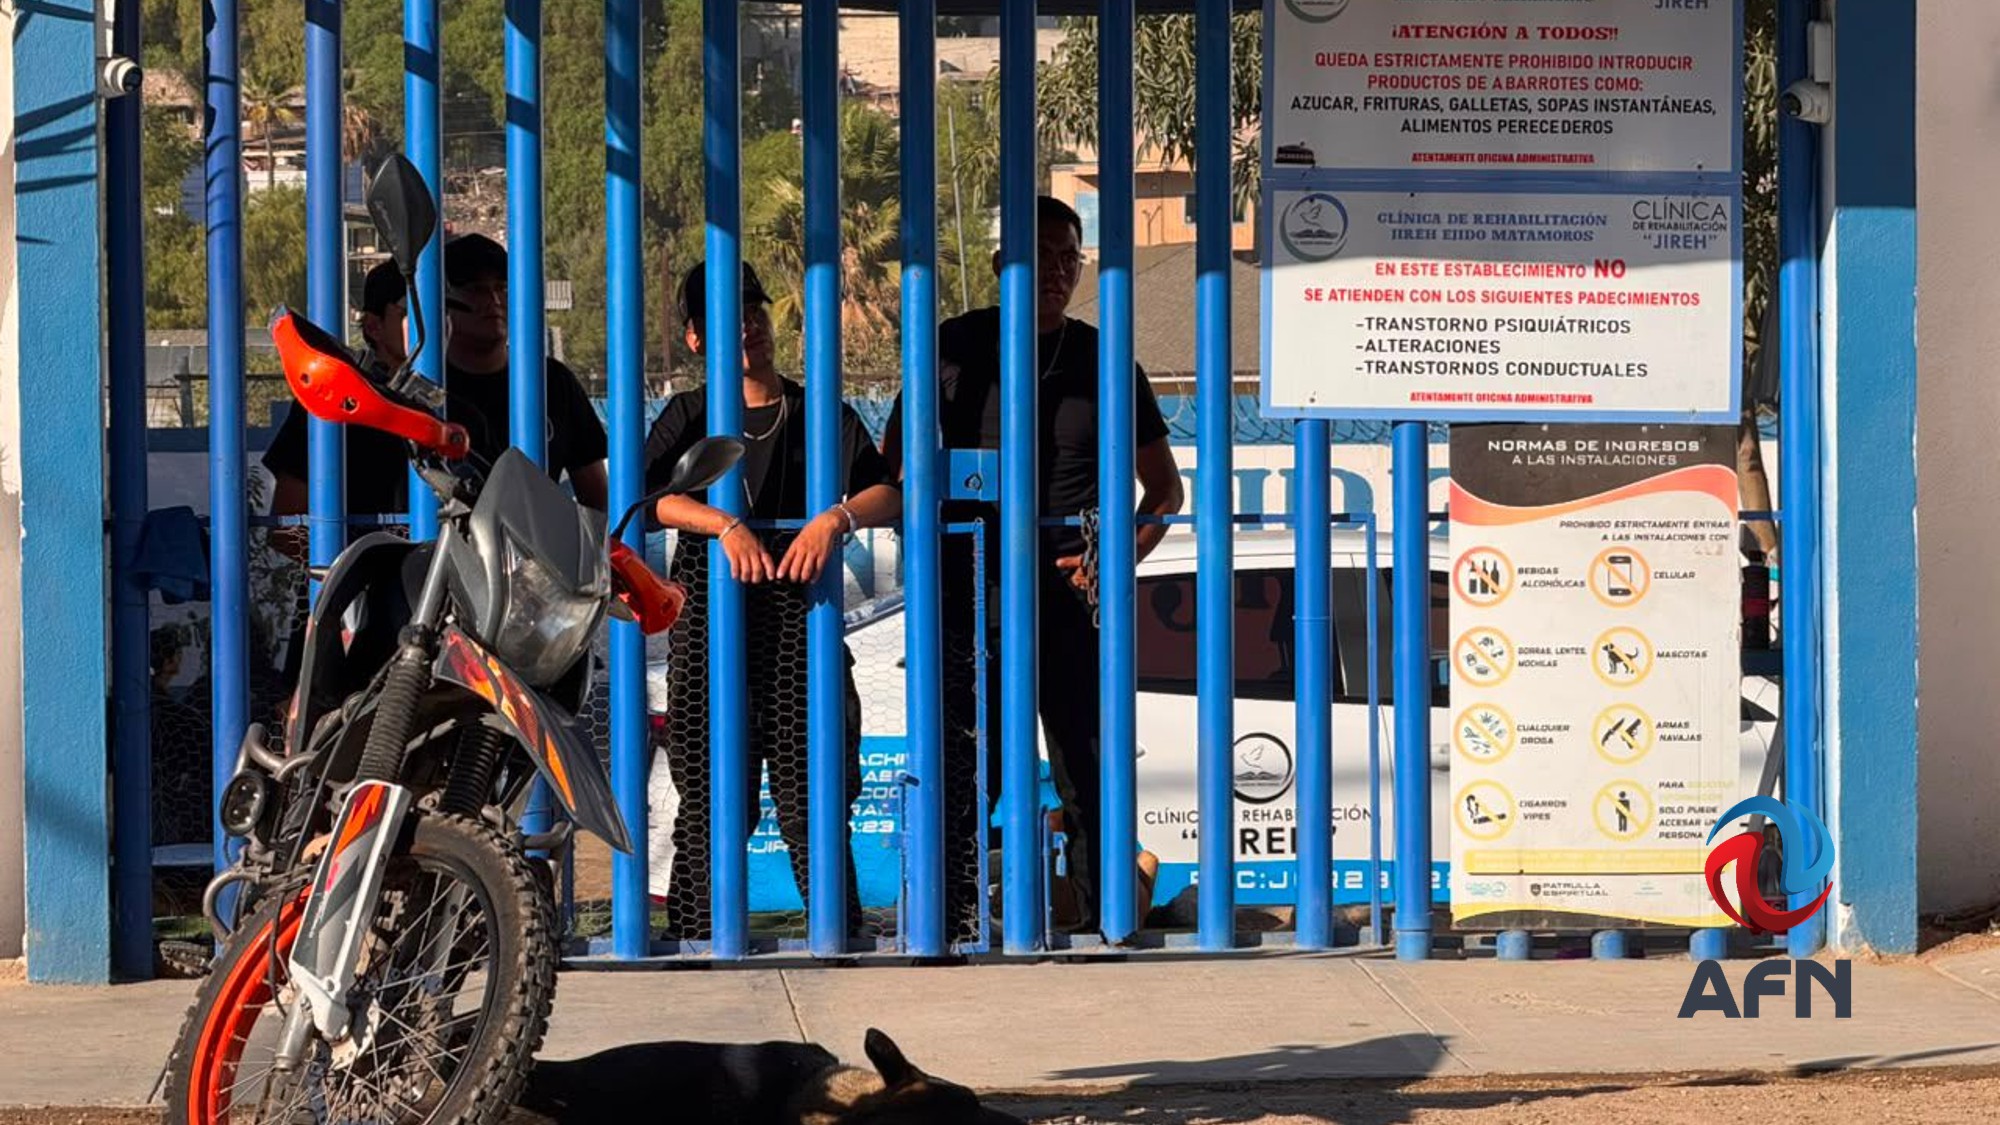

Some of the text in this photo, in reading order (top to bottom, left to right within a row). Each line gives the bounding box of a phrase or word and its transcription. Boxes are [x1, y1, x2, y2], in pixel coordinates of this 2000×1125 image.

[1391, 22, 1618, 40] ¡ATENCIÓN A TODOS!!
[1315, 53, 1692, 70] QUEDA ESTRICTAMENTE PROHIBIDO INTRODUCIR
[1368, 75, 1461, 89] PRODUCTOS
[1467, 76, 1487, 90] DE
[1595, 77, 1642, 91] COMO:
[1291, 96, 1716, 114] AZUCAR, FRITURAS, GALLETAS, SOPAS INSTANTÁNEAS,
[1401, 119, 1613, 134] ALIMENTOS PERECEDEROS
[1412, 153, 1595, 163] ATENTAMENTE OFICINA ADMINISTRATIVA
[1632, 196, 1728, 221] CLÍNICA
[1378, 211, 1607, 226] CLÍNICA DE REHABILITACIÓN
[1633, 220, 1728, 232] DE REHABILITACIÓN
[1392, 229, 1436, 240] JIREH
[1492, 230, 1593, 241] MATAMOROS
[1376, 260, 1626, 279] EN ESTE ESTABLECIMIENTO NO
[1305, 288, 1700, 306] SE ATIENDEN CON LOS SIGUIENTES PADECIMIENTOS
[1357, 316, 1631, 334] -TRANSTORNO PSIQUIÁTRICOS
[1356, 339, 1500, 354] -ALTERACIONES
[1356, 361, 1647, 377] -TRANSTORNOS CONDUCTUALES
[1410, 392, 1593, 404] ATENTAMENTE OFICINA ADMINISTRATIVA
[1489, 440, 1699, 452] NORMAS DE INGRESOS
[1512, 455, 1677, 466] A LAS INSTALACIONES
[1560, 521, 1730, 529] PROHIBIDO ESTRICTAMENTE ENTRAR
[1612, 534, 1630, 542] LAS
[1634, 534, 1705, 542] INSTALACIONES
[1518, 567, 1558, 575] BEBIDAS
[1654, 572, 1695, 580] CELULAR
[1657, 651, 1707, 659] MASCOTAS
[1518, 660, 1557, 668] MOCHILAS
[1517, 725, 1570, 733] CUALQUIER
[1521, 737, 1553, 745] DROGA
[1660, 734, 1702, 742] NAVAJAS
[1519, 800, 1567, 808] CIGARROS
[1144, 807, 1199, 824] CLÍNIC
[1659, 806, 1717, 815] SOLO PUEDE
[1524, 813, 1550, 821] VIPES
[1659, 819, 1701, 827] ACCESAR
[1659, 832, 1703, 840] PERSONA
